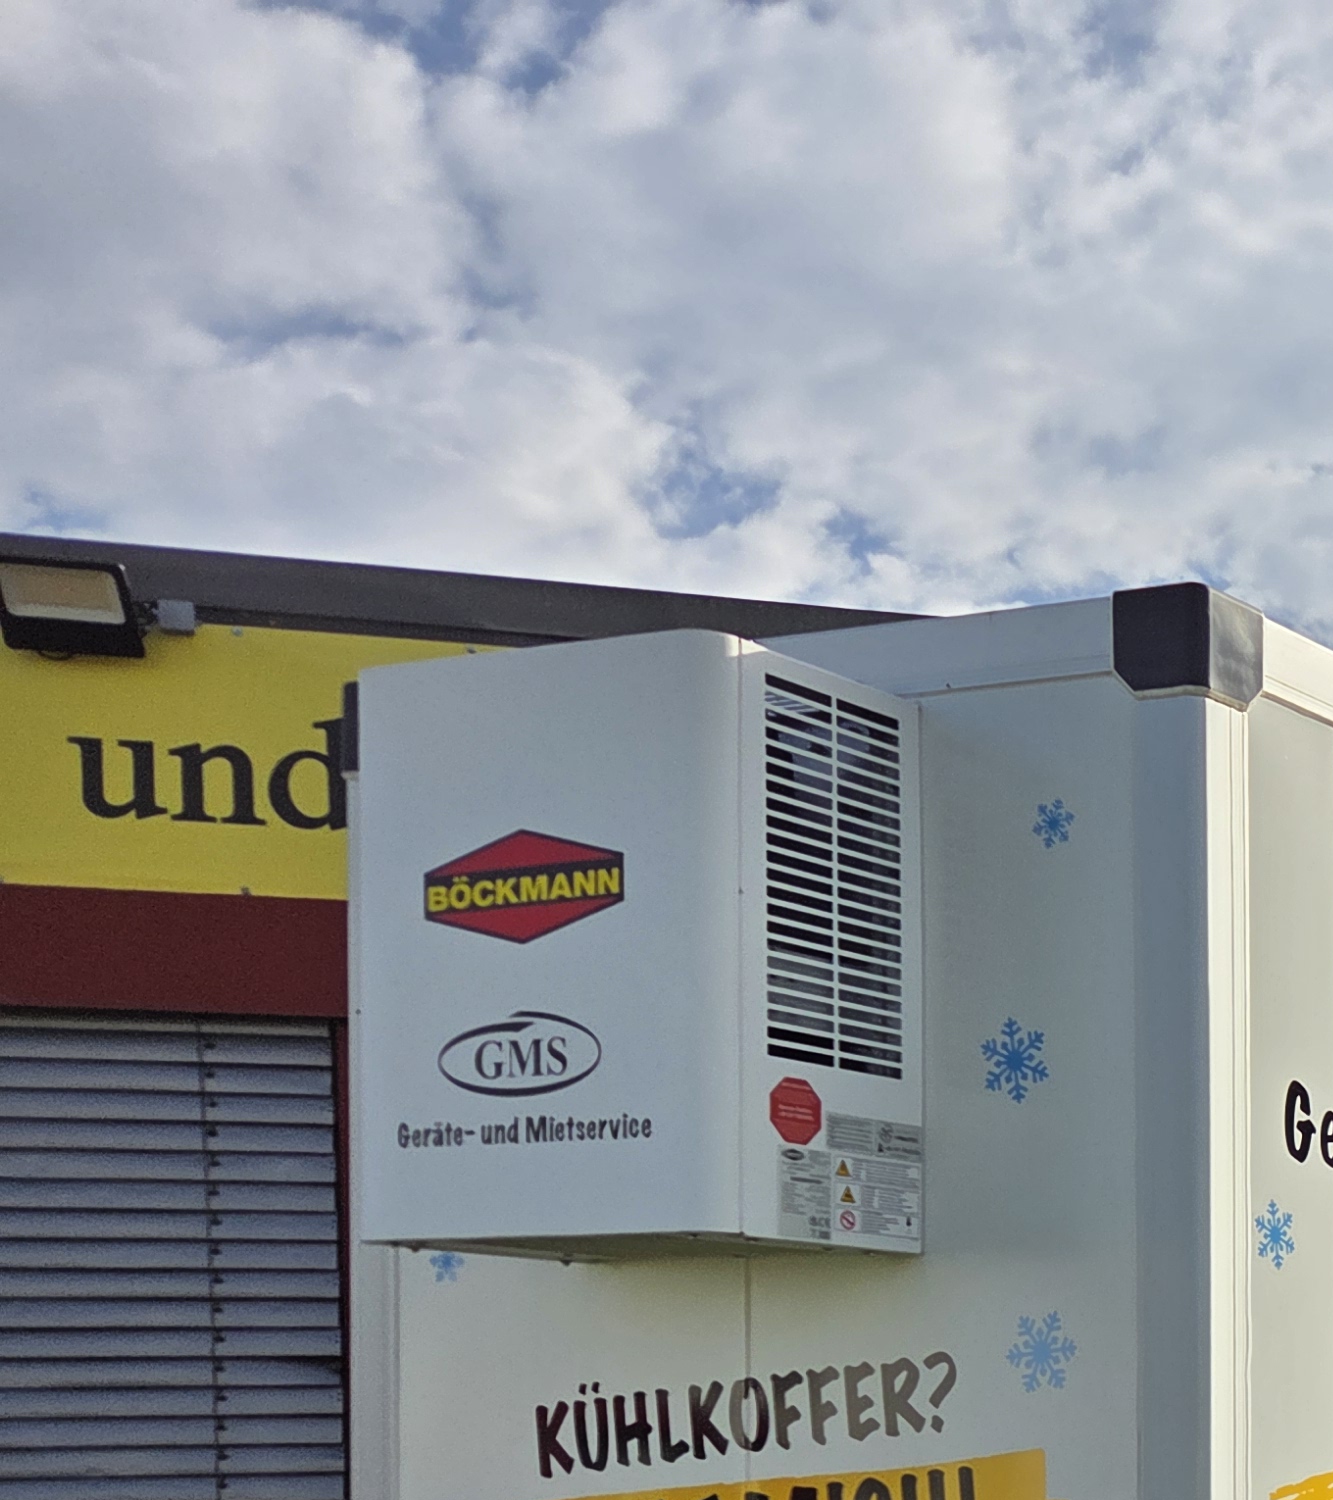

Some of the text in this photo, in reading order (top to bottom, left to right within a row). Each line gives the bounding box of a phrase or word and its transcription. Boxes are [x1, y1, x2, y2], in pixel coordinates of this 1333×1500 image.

[66, 717, 348, 831] und
[426, 866, 621, 914] BÖCKMANN
[474, 1036, 568, 1080] GMS
[397, 1113, 652, 1148] Geräte- und Mietservice
[535, 1351, 958, 1478] KÜHLKOFFER?
